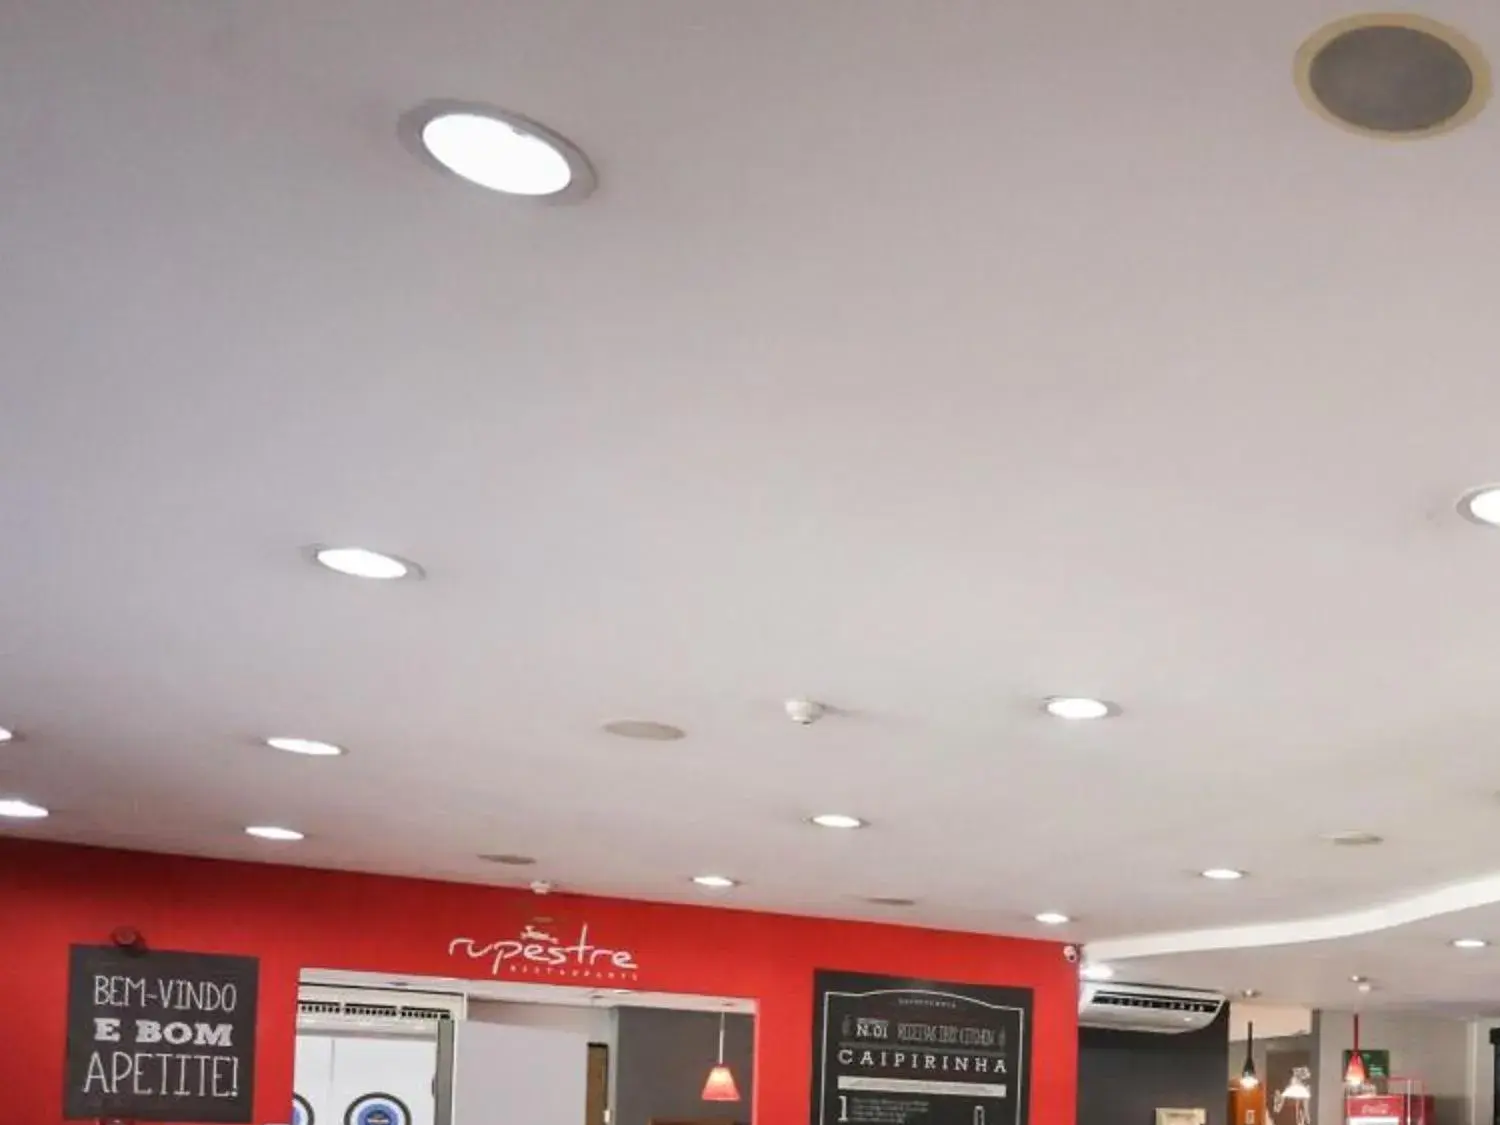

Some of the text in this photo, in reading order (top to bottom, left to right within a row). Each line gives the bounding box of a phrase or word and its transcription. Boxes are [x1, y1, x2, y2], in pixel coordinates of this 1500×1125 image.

[448, 920, 638, 976] rupestre
[93, 975, 237, 1012] BEM-VINDO
[94, 1018, 234, 1047] E BOM
[82, 1051, 239, 1098] APETITE!
[837, 1049, 1008, 1075] CAIPIRINHA
[837, 1095, 849, 1122] 1
